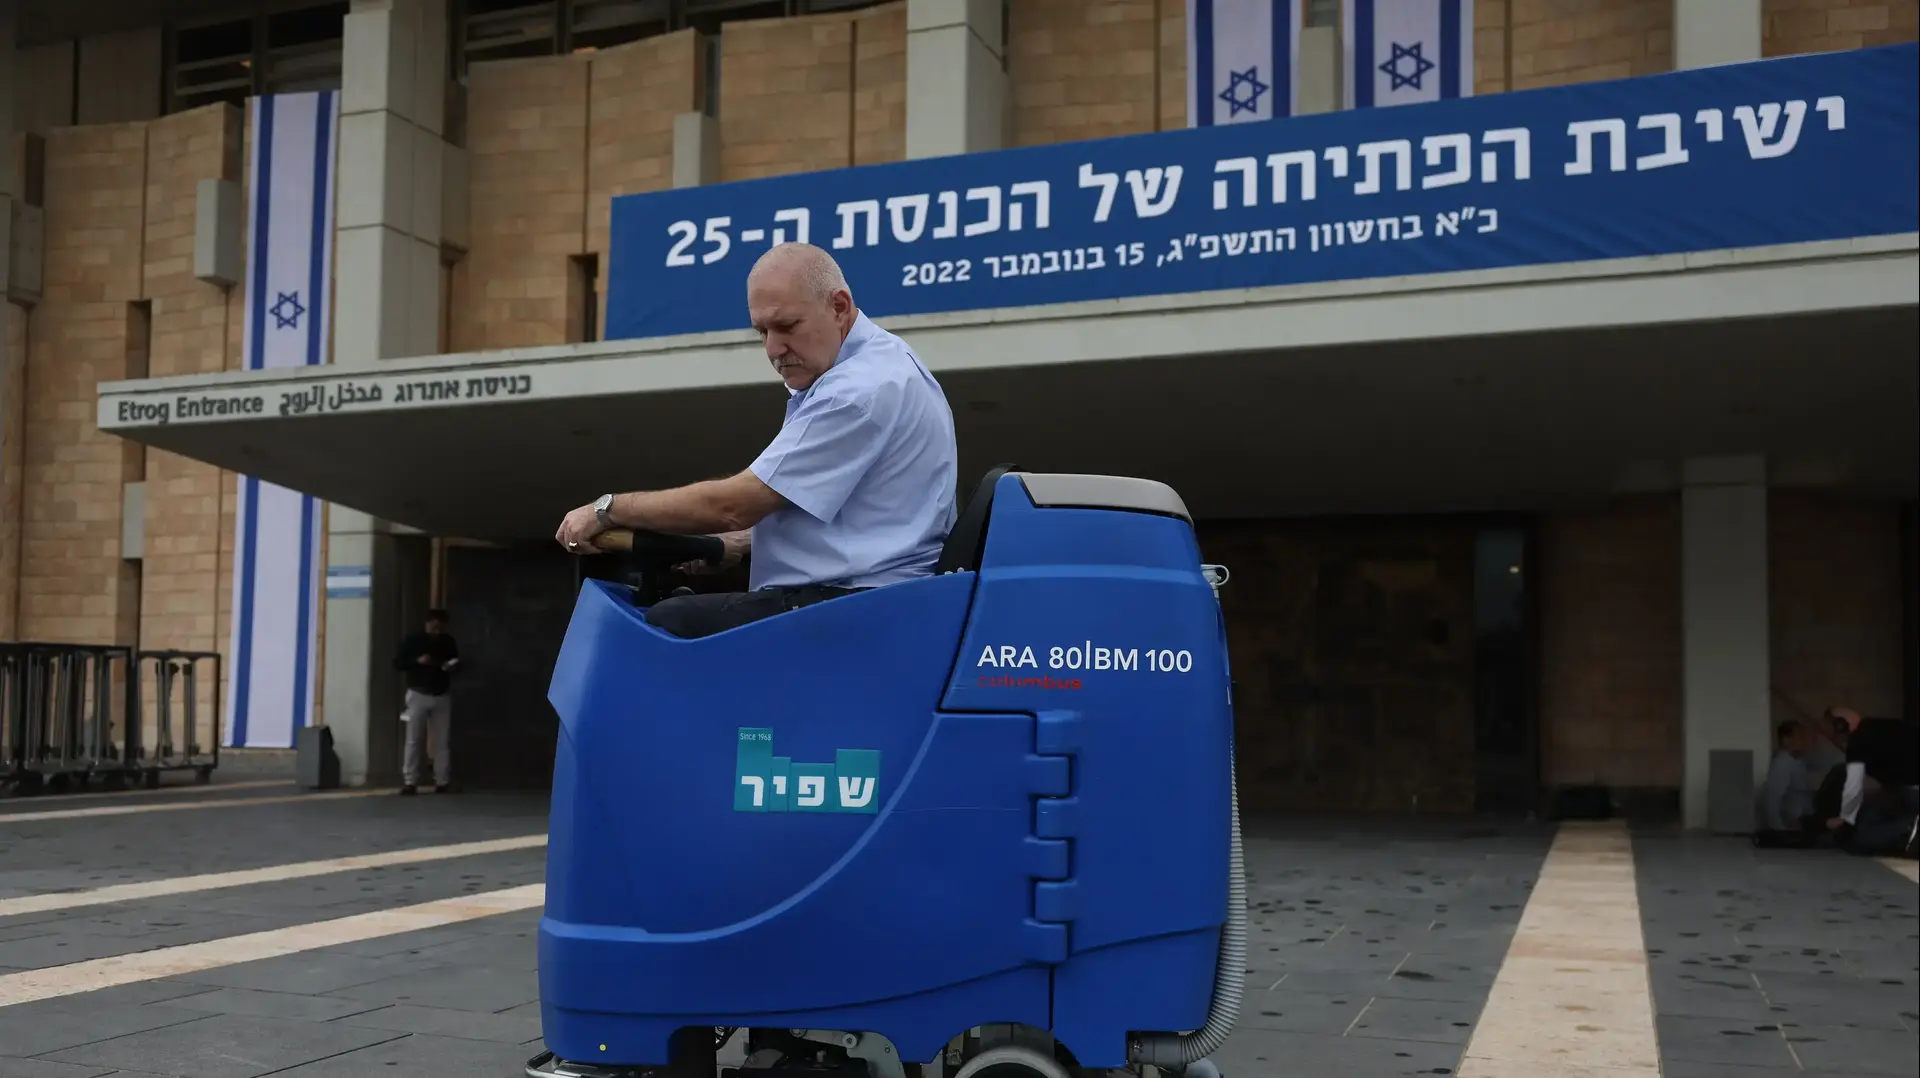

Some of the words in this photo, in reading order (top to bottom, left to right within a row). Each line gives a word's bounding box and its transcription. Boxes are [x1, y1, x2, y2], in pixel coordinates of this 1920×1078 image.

[1564, 95, 1846, 176] ישיבת
[1213, 127, 1531, 210] הפתיחה
[1079, 163, 1184, 222] של
[832, 180, 1050, 250] הכנסת
[1308, 215, 1424, 252] בחשוון
[983, 246, 1106, 278] בנובמבר
[1114, 242, 1145, 266] 15
[902, 259, 972, 287] 2022
[328, 382, 383, 411] مدخل
[394, 379, 460, 403] אתרוג
[465, 374, 531, 399] כניסת
[118, 400, 170, 425] Etrog
[176, 396, 263, 418] Entrance
[977, 645, 1038, 668] ARA
[1145, 649, 1193, 673] 100
[739, 732, 756, 741] Since
[757, 733, 772, 742] 1968
[741, 775, 876, 808] שפיר
